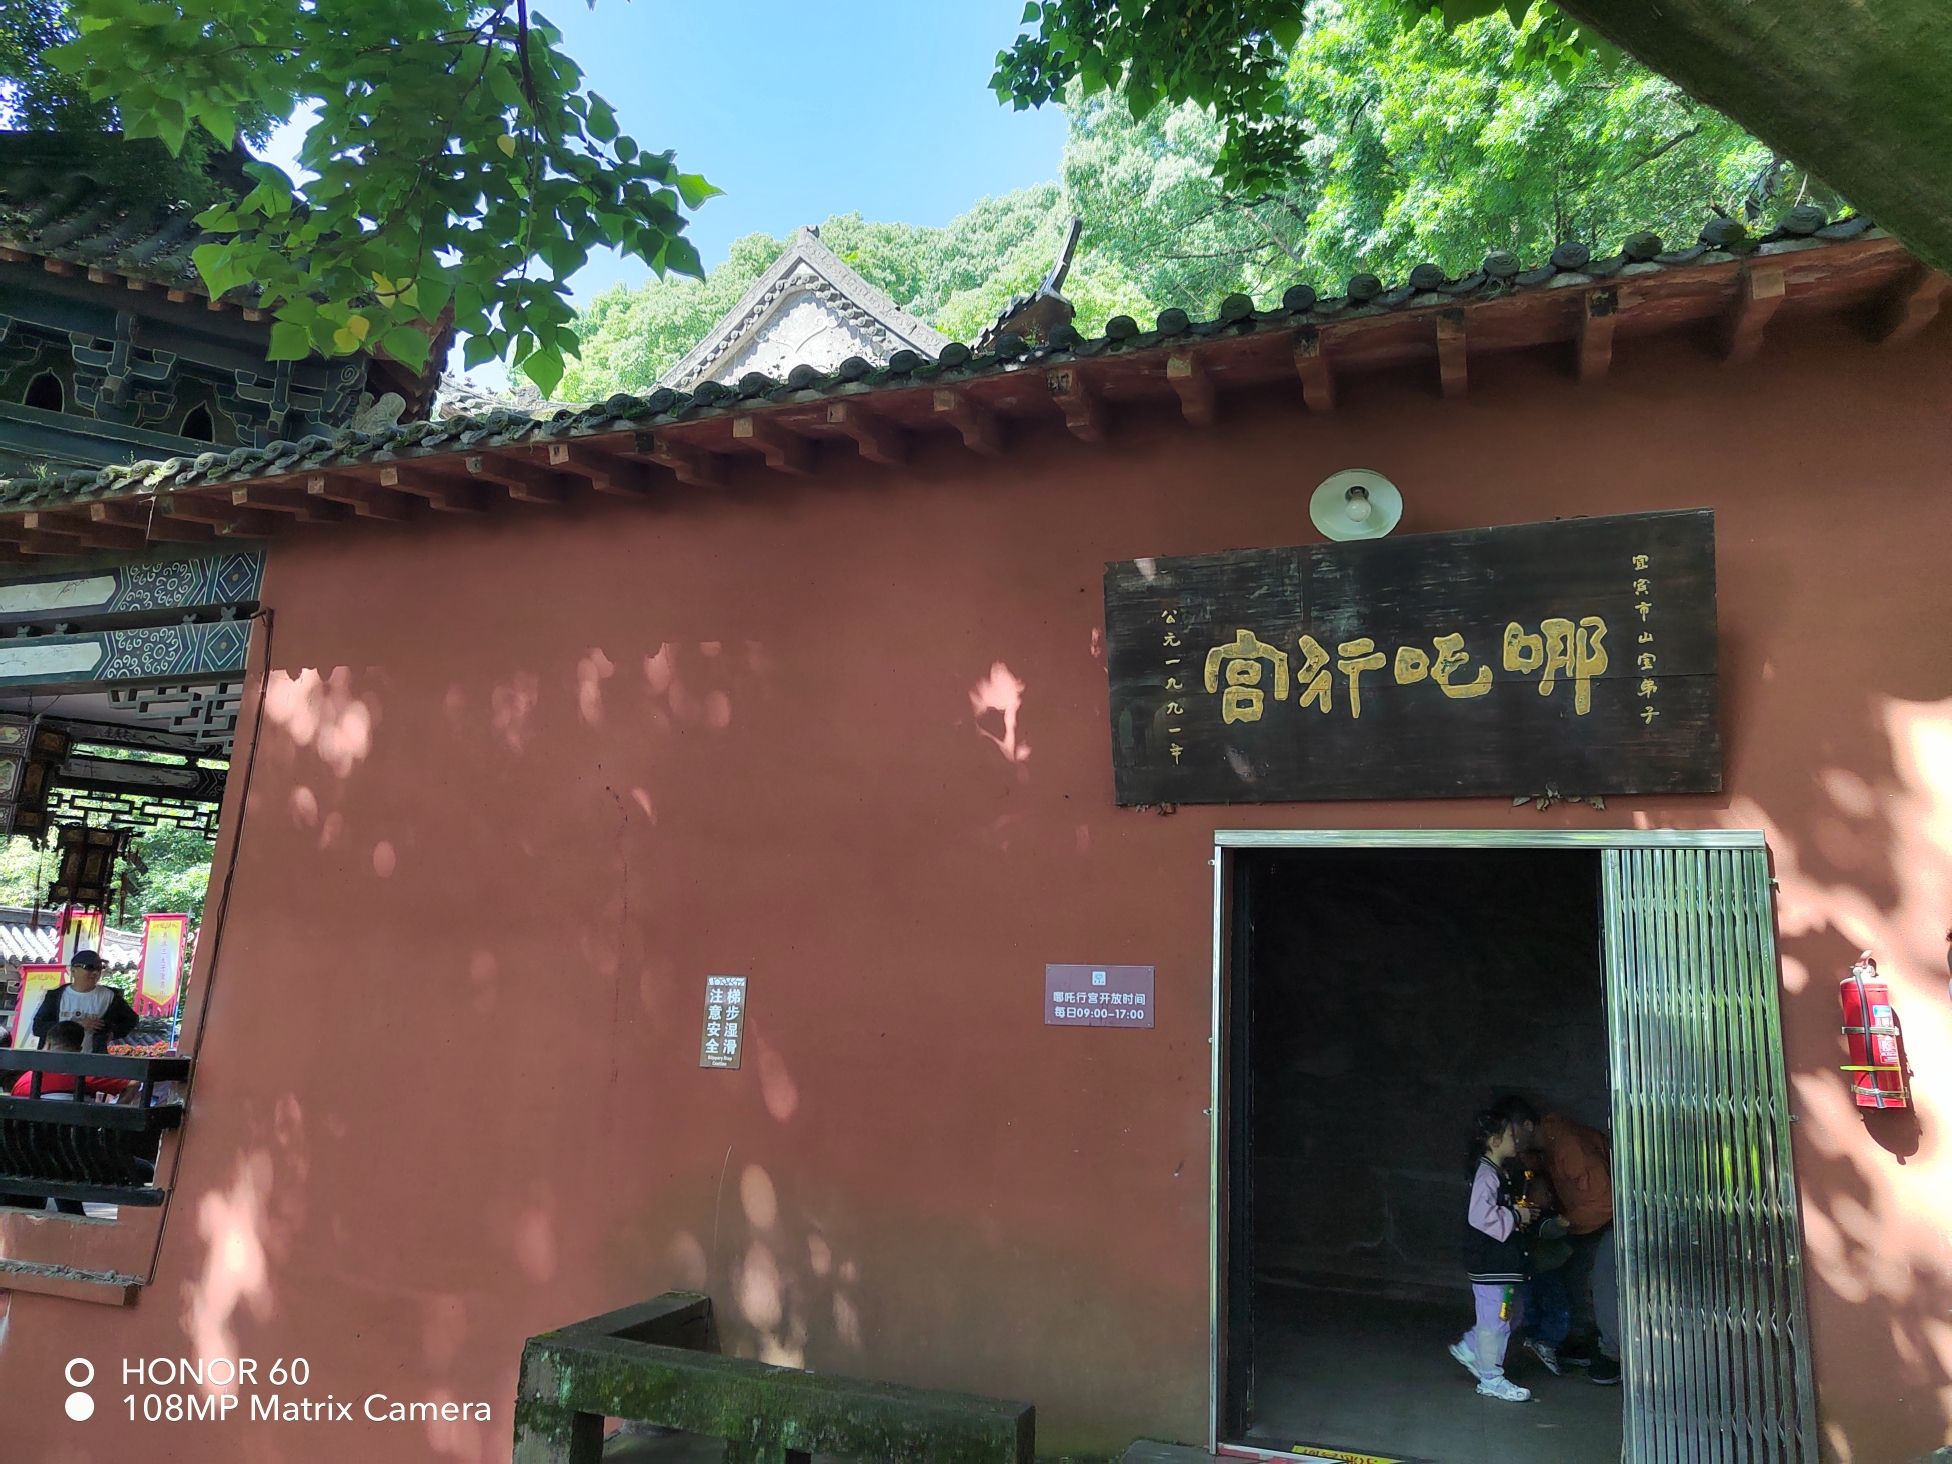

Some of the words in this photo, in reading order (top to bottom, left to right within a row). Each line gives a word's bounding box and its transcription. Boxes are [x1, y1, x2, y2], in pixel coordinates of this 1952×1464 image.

[1161, 609, 1184, 766] 公元一九九一年
[705, 988, 724, 1054] 注意安全
[722, 988, 741, 1055] 梯步湿滑
[1053, 991, 1146, 1005] 哪吒行宫开放时间
